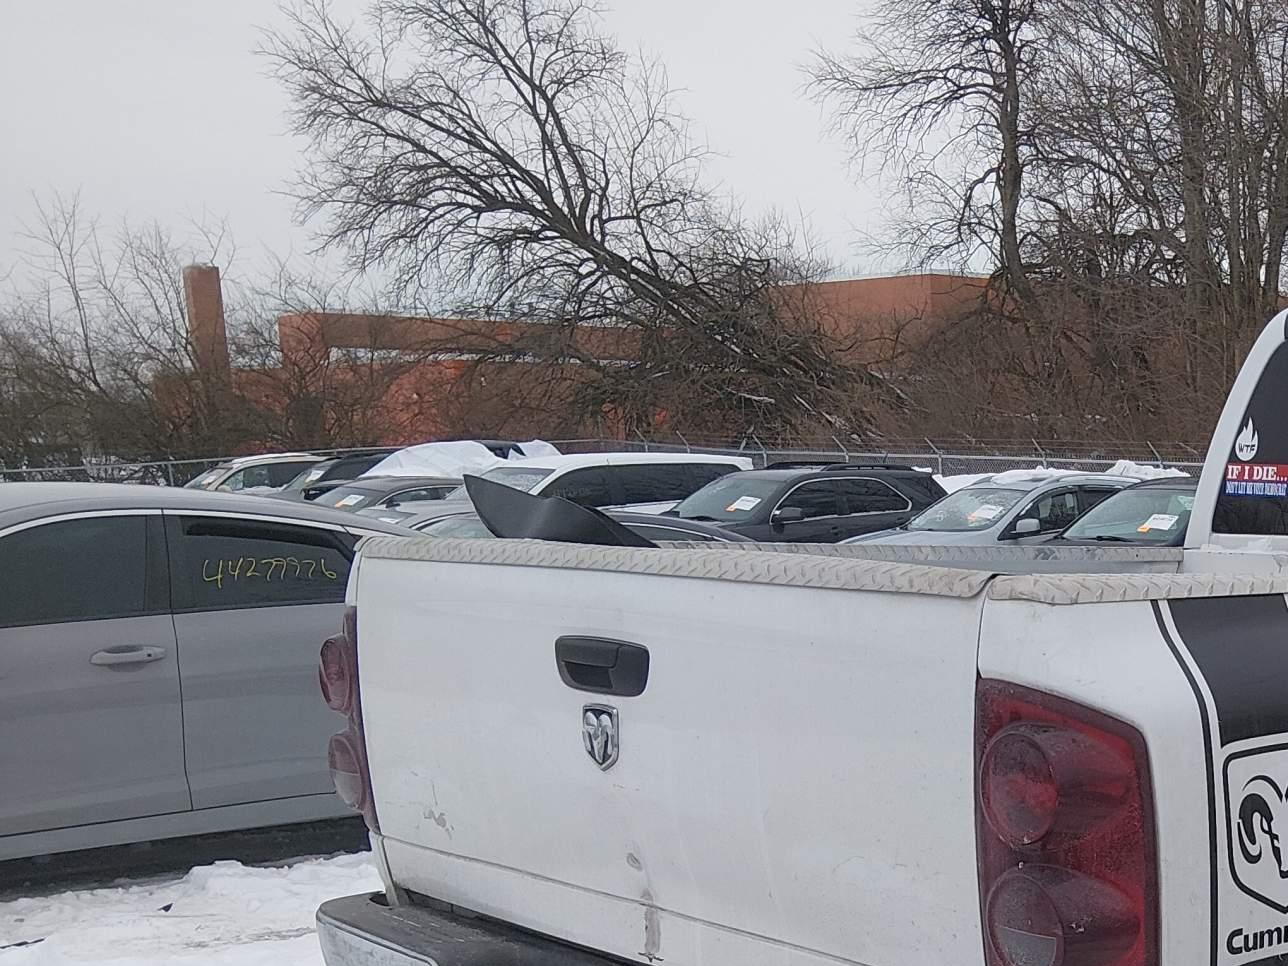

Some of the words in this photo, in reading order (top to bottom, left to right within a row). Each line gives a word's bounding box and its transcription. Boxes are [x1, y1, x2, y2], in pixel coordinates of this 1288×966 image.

[1238, 443, 1256, 453] WTF
[1227, 465, 1241, 479] IF
[1244, 465, 1250, 480] I
[1253, 466, 1288, 481] DIE...
